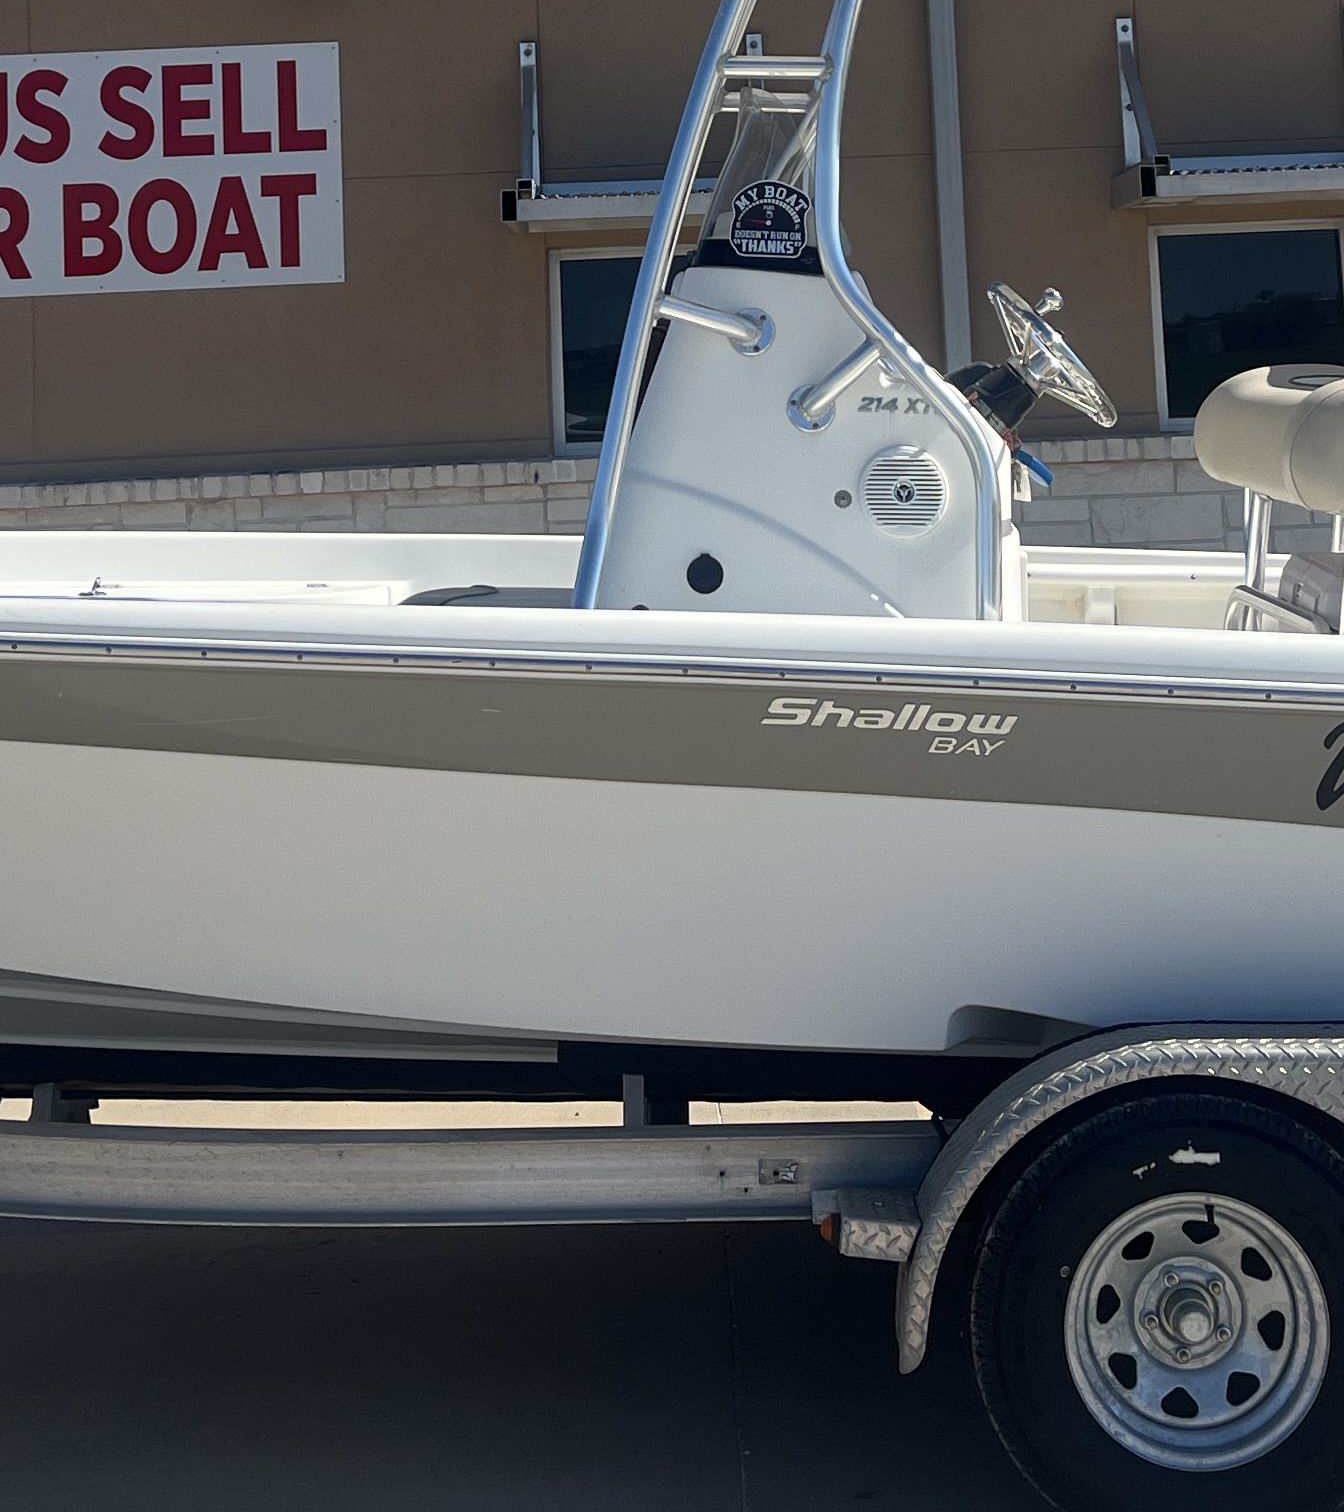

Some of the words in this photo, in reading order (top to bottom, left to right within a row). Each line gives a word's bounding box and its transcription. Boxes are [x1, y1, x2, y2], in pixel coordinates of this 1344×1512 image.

[98, 60, 328, 161] SELL
[735, 188, 758, 210] MY
[764, 185, 808, 212] BOAT
[62, 173, 318, 278] BOAT
[735, 230, 769, 238] DOESN'T
[770, 231, 788, 239] RUN
[789, 232, 802, 241] ON
[857, 396, 899, 414] 214
[760, 696, 1019, 736] Shallow
[928, 736, 1006, 756] BAY
